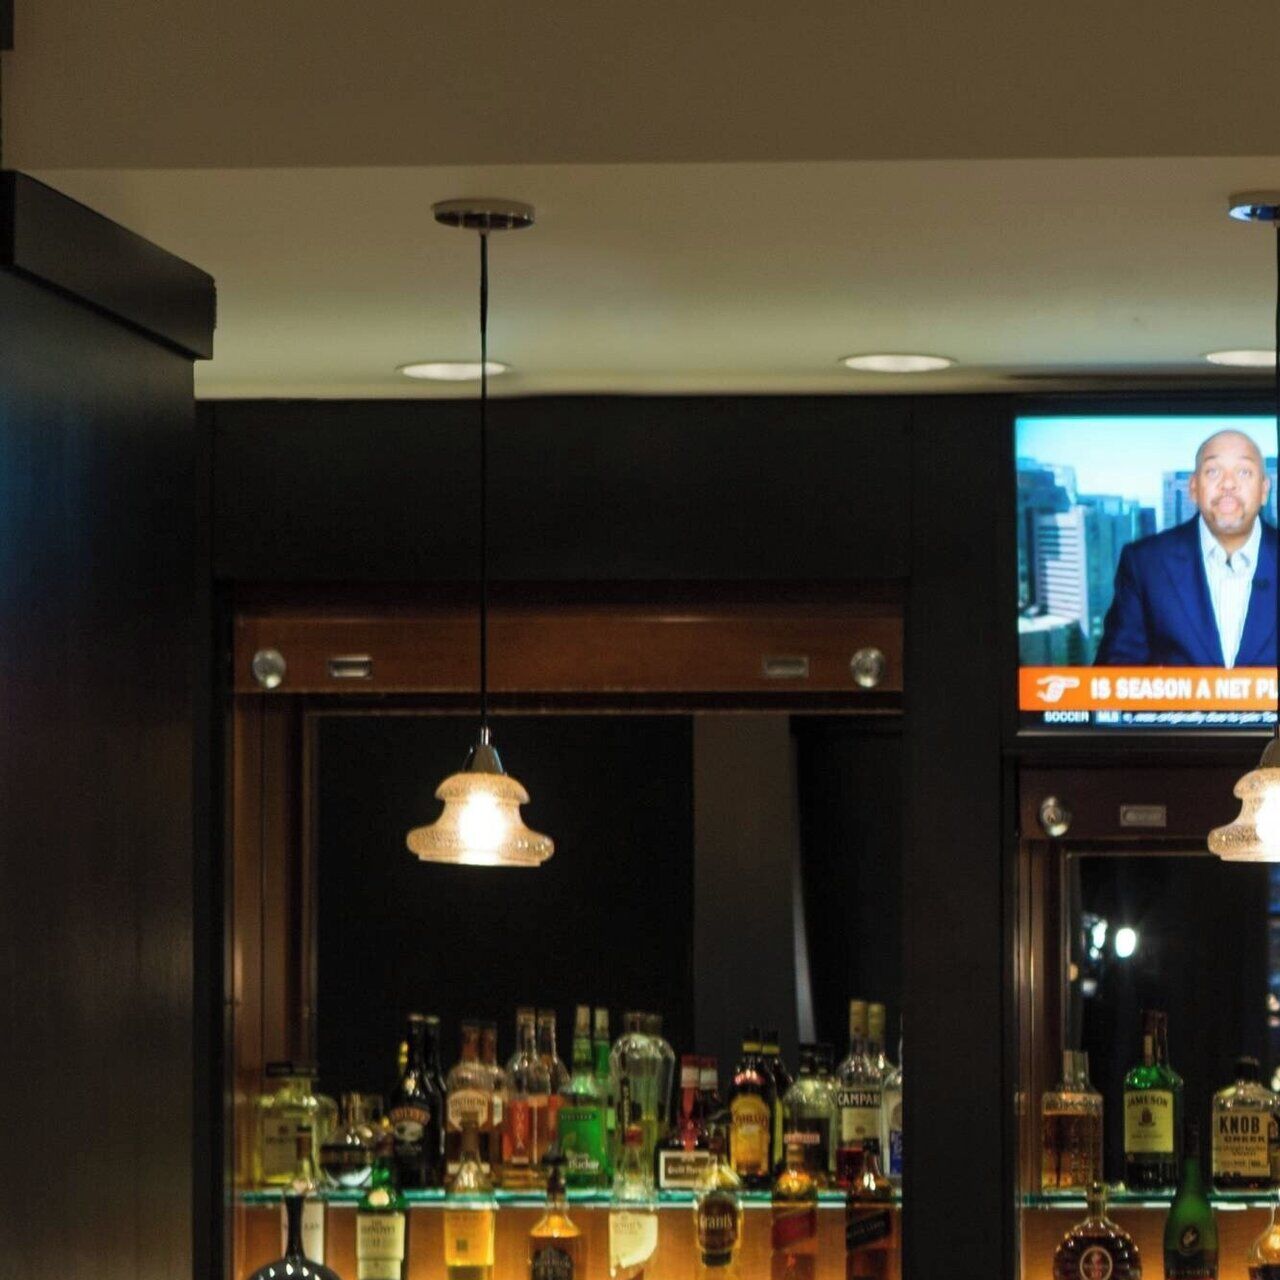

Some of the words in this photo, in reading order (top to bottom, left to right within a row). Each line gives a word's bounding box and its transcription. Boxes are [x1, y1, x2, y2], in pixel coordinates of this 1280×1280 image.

[1091, 676, 1111, 700] IS
[1115, 676, 1192, 700] SEASON
[1195, 677, 1212, 700] A
[1215, 676, 1252, 700] NET
[1044, 711, 1089, 723] SOCCER
[1126, 1094, 1168, 1108] JAMESON
[1219, 1116, 1260, 1134] KNOB
